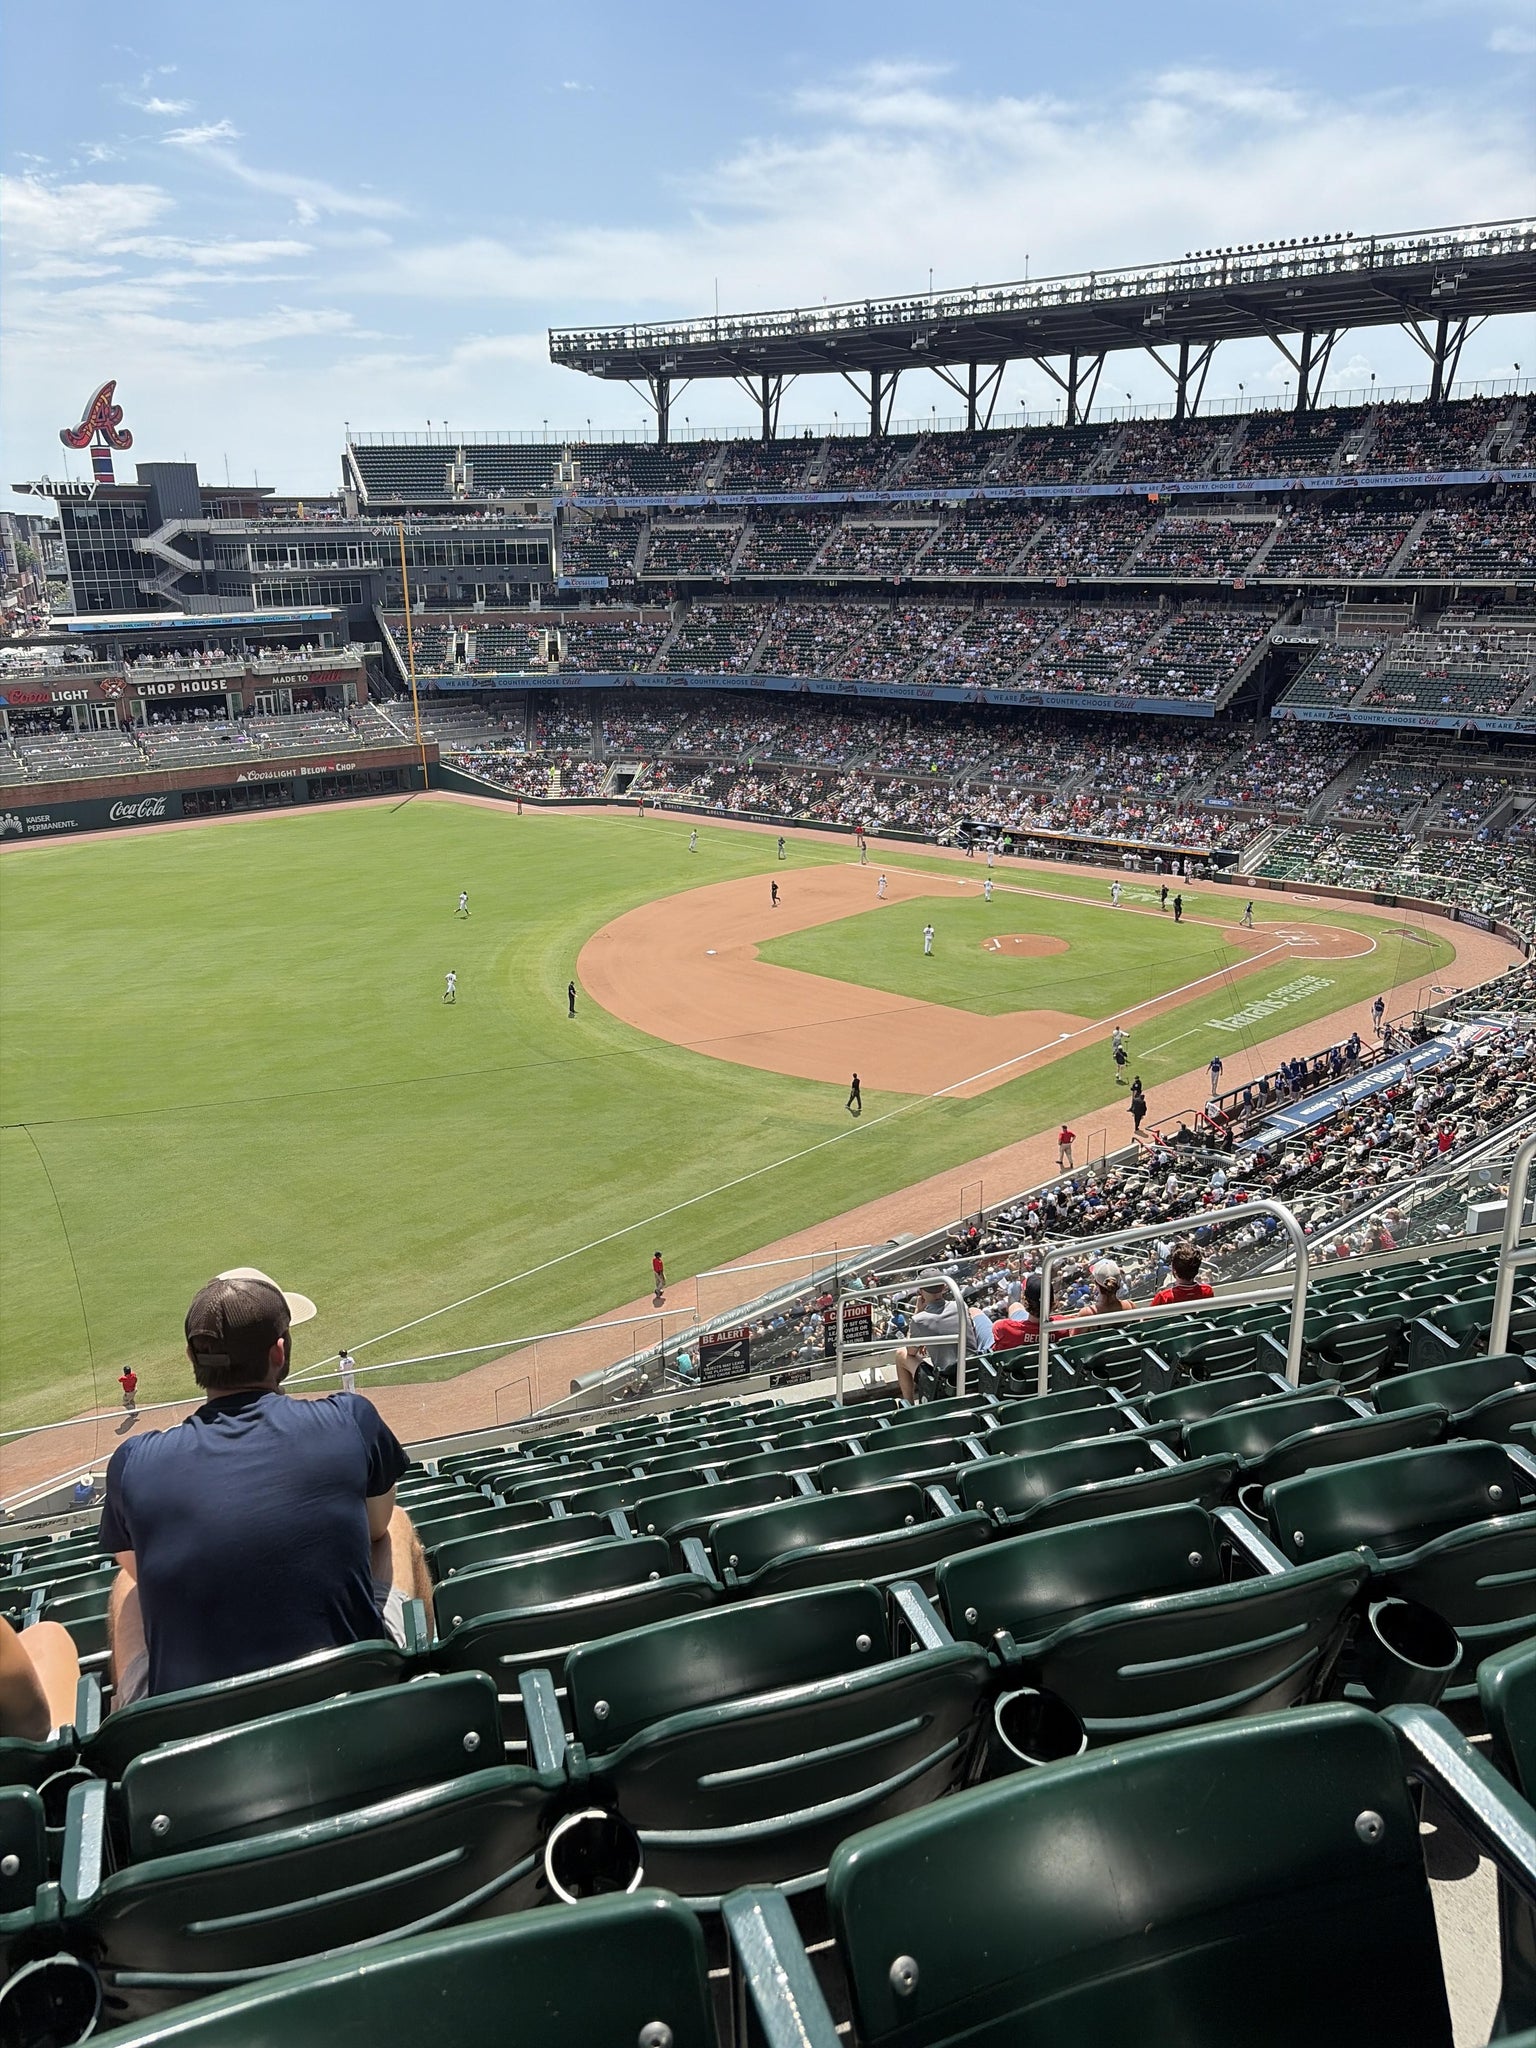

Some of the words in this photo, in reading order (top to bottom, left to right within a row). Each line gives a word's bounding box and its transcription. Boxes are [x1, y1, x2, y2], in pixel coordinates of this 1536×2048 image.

[27, 475, 100, 501] xfinity
[272, 676, 295, 684] MADE
[138, 684, 176, 695] CHOP
[181, 680, 227, 692] HOUSE
[8, 690, 50, 703] Coors
[52, 690, 88, 702] LIGHT
[1046, 698, 1080, 706] COUNTRY,
[247, 770, 273, 780] Coors
[274, 770, 296, 778] LIGHT
[26, 815, 50, 824] KAISER
[1459, 910, 1489, 925] NORTHSIDE
[1464, 919, 1483, 928] HOSPITAL
[1283, 978, 1335, 1002] CASINOS
[830, 1306, 867, 1320] CUTION
[702, 1335, 714, 1344] BE
[717, 1329, 744, 1342] ALERT
